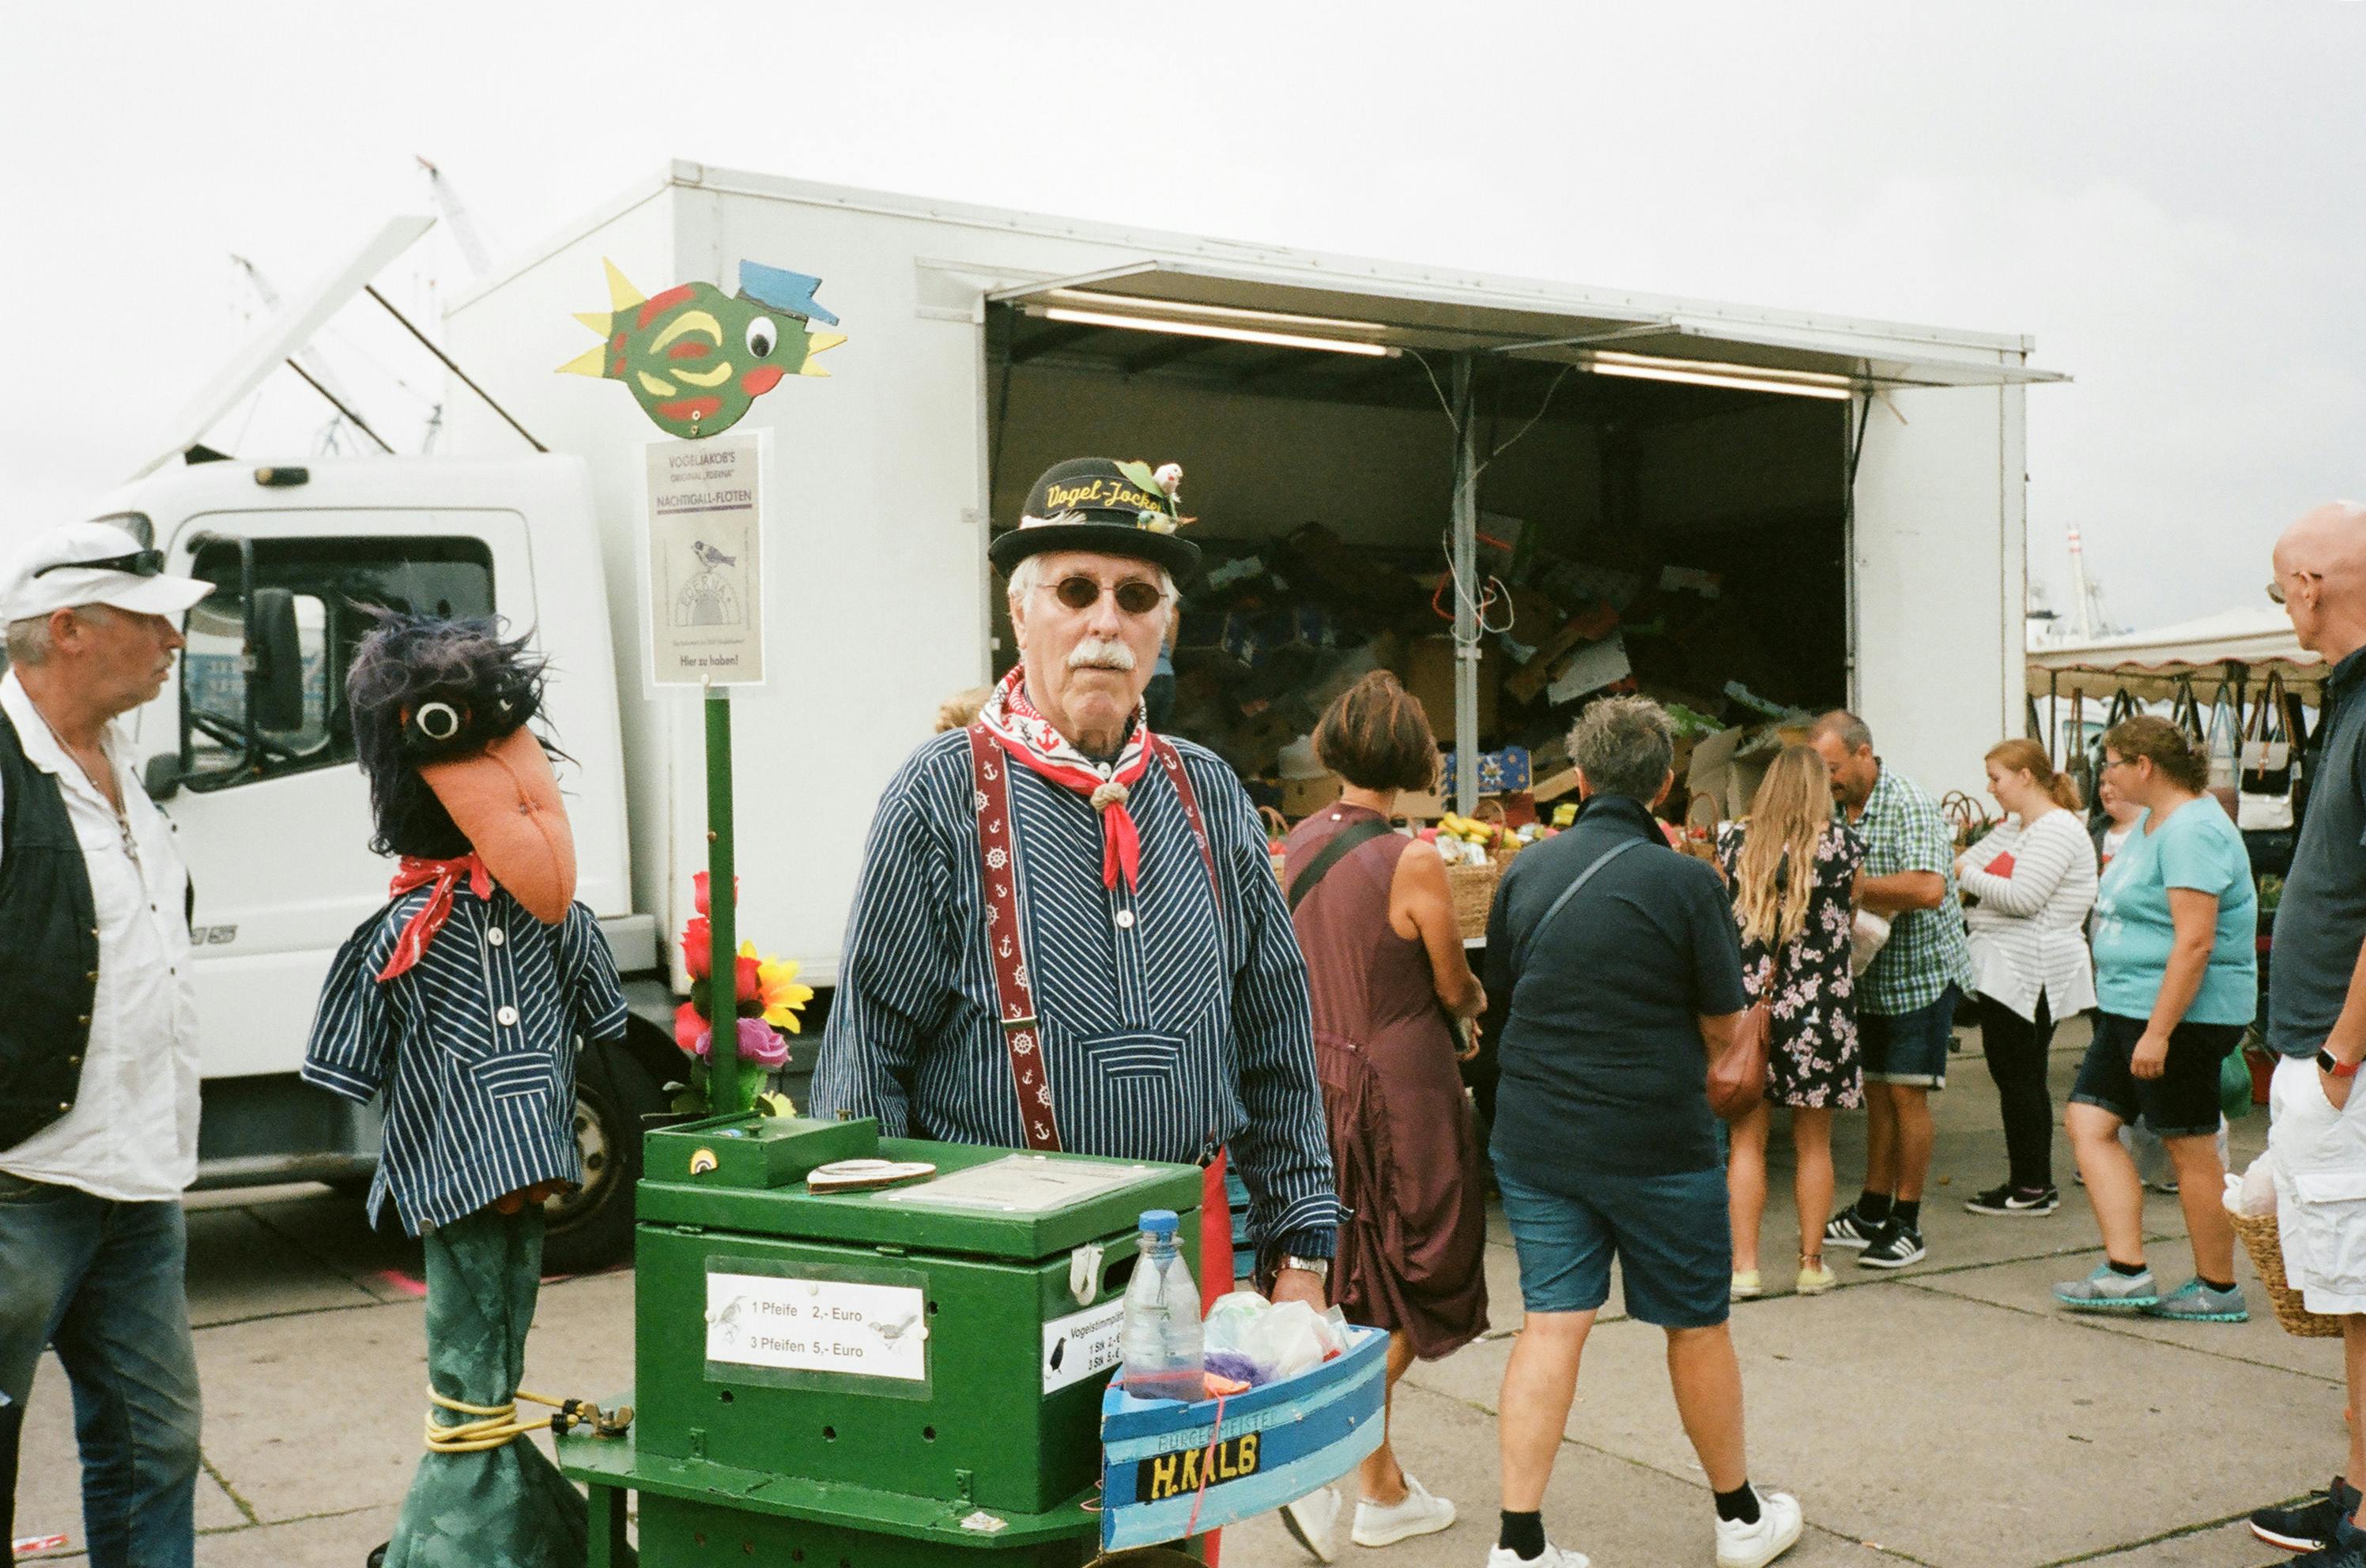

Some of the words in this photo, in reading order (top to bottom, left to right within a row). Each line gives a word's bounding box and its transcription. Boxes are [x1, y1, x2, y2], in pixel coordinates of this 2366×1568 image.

[668, 451, 736, 468] VOGELJAKOB'S
[680, 655, 696, 666] Hier
[709, 654, 739, 666] haben!
[753, 1302, 758, 1314] 1
[762, 1302, 798, 1317] Pfeife
[813, 1306, 828, 1320] 2,-
[832, 1307, 862, 1321] Euro
[750, 1336, 758, 1348] 3
[761, 1337, 806, 1353] Pfeifen
[813, 1342, 829, 1356] 5,-
[833, 1344, 864, 1358] Euro
[1095, 1340, 1104, 1353] Stk
[1094, 1355, 1104, 1368] Stk
